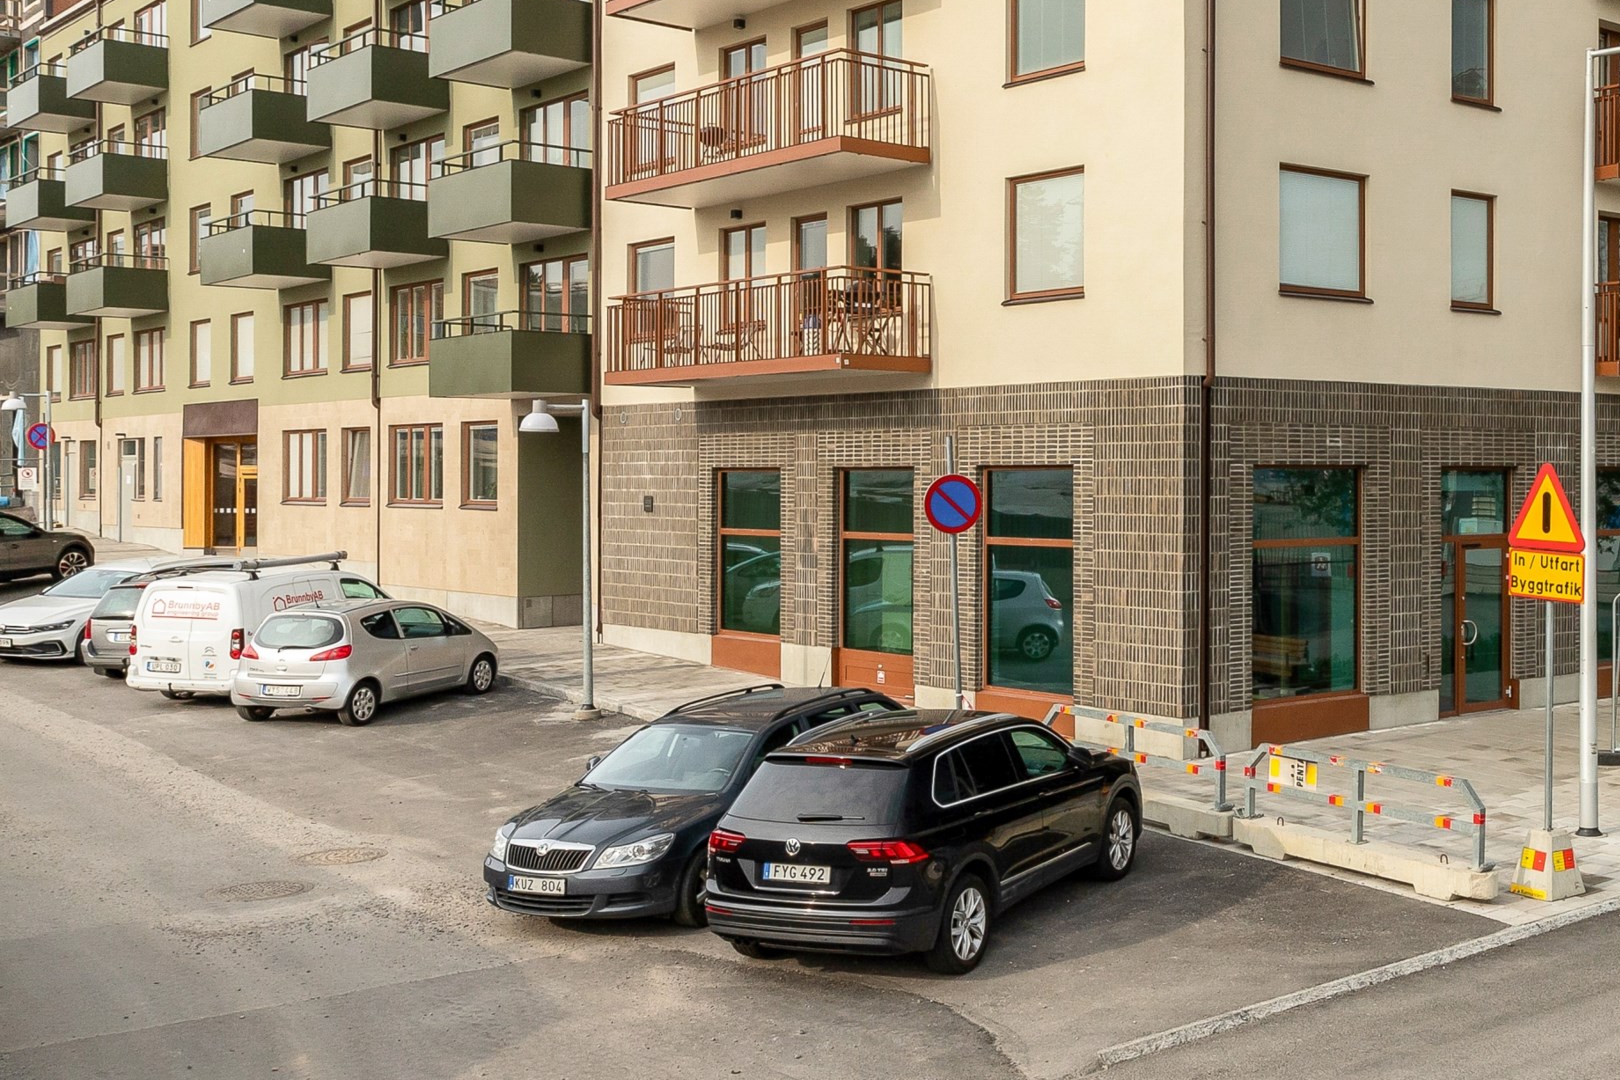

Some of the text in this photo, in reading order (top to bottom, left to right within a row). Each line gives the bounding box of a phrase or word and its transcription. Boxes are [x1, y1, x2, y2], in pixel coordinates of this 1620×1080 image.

[1514, 553, 1579, 572] In / Utfart
[1511, 575, 1581, 596] Byggtrafik
[168, 600, 220, 611] BrunnbyAB
[773, 865, 825, 881] FYG 492
[515, 876, 561, 892] KUZ 804
